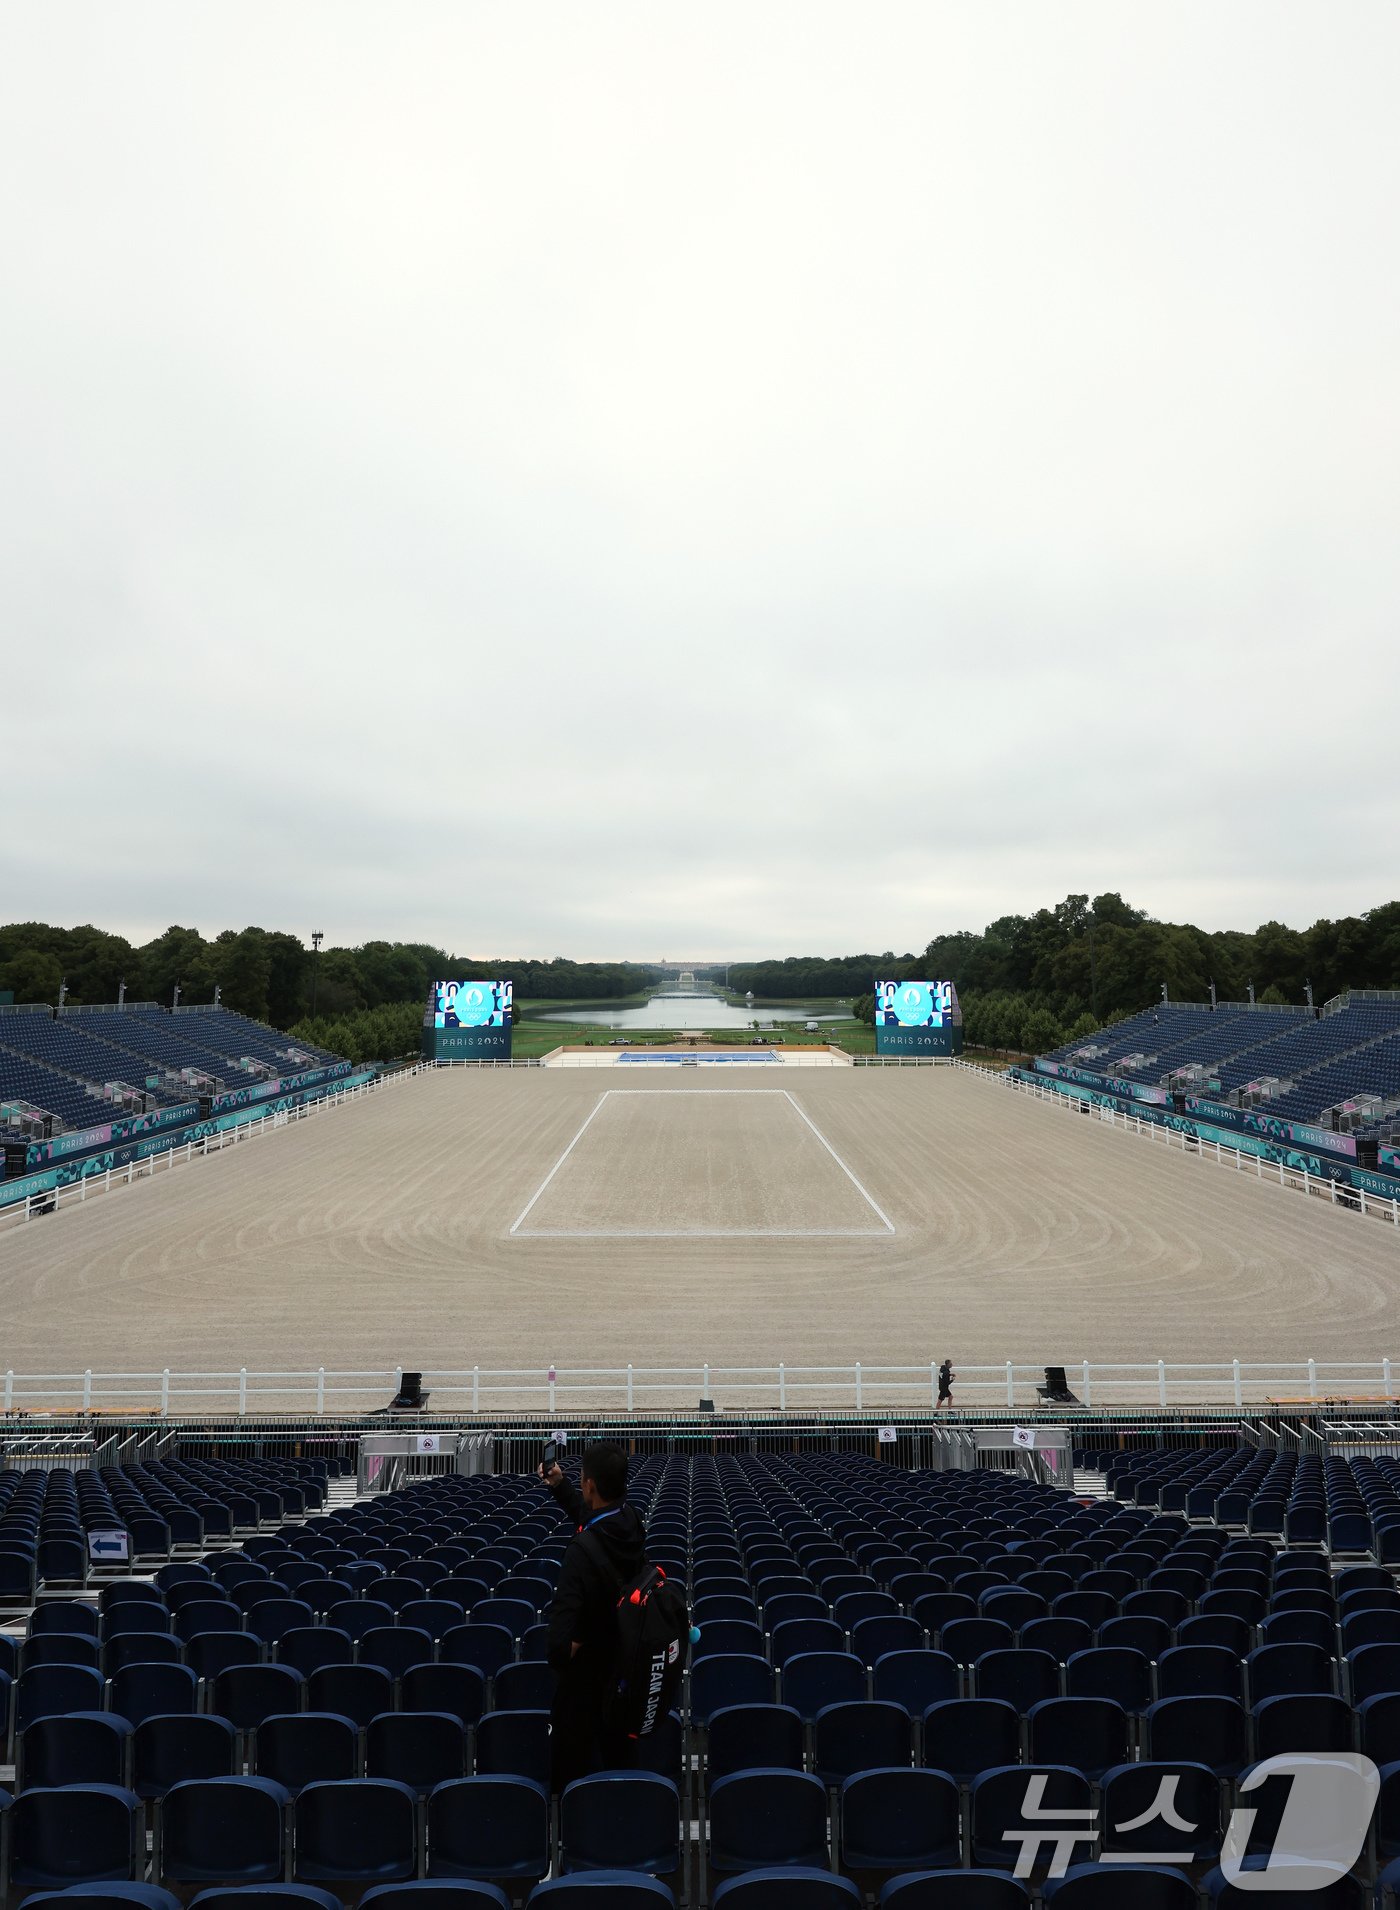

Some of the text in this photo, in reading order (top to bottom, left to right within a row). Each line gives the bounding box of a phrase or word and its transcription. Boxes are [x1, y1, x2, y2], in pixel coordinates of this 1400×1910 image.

[442, 1037, 505, 1046] PARIS 2024
[917, 1037, 946, 1046] 2024
[165, 1107, 196, 1121] PARIS 2024
[1203, 1105, 1236, 1120] PARIS 2024
[61, 1132, 104, 1150] PARIS 2024
[143, 1136, 177, 1152] PARIS 2024
[1300, 1131, 1347, 1149] PARIS 2024
[26, 1180, 48, 1192] 2024
[1360, 1177, 1387, 1192] PARIS
[640, 1651, 665, 1734] TEAM JAPAN
